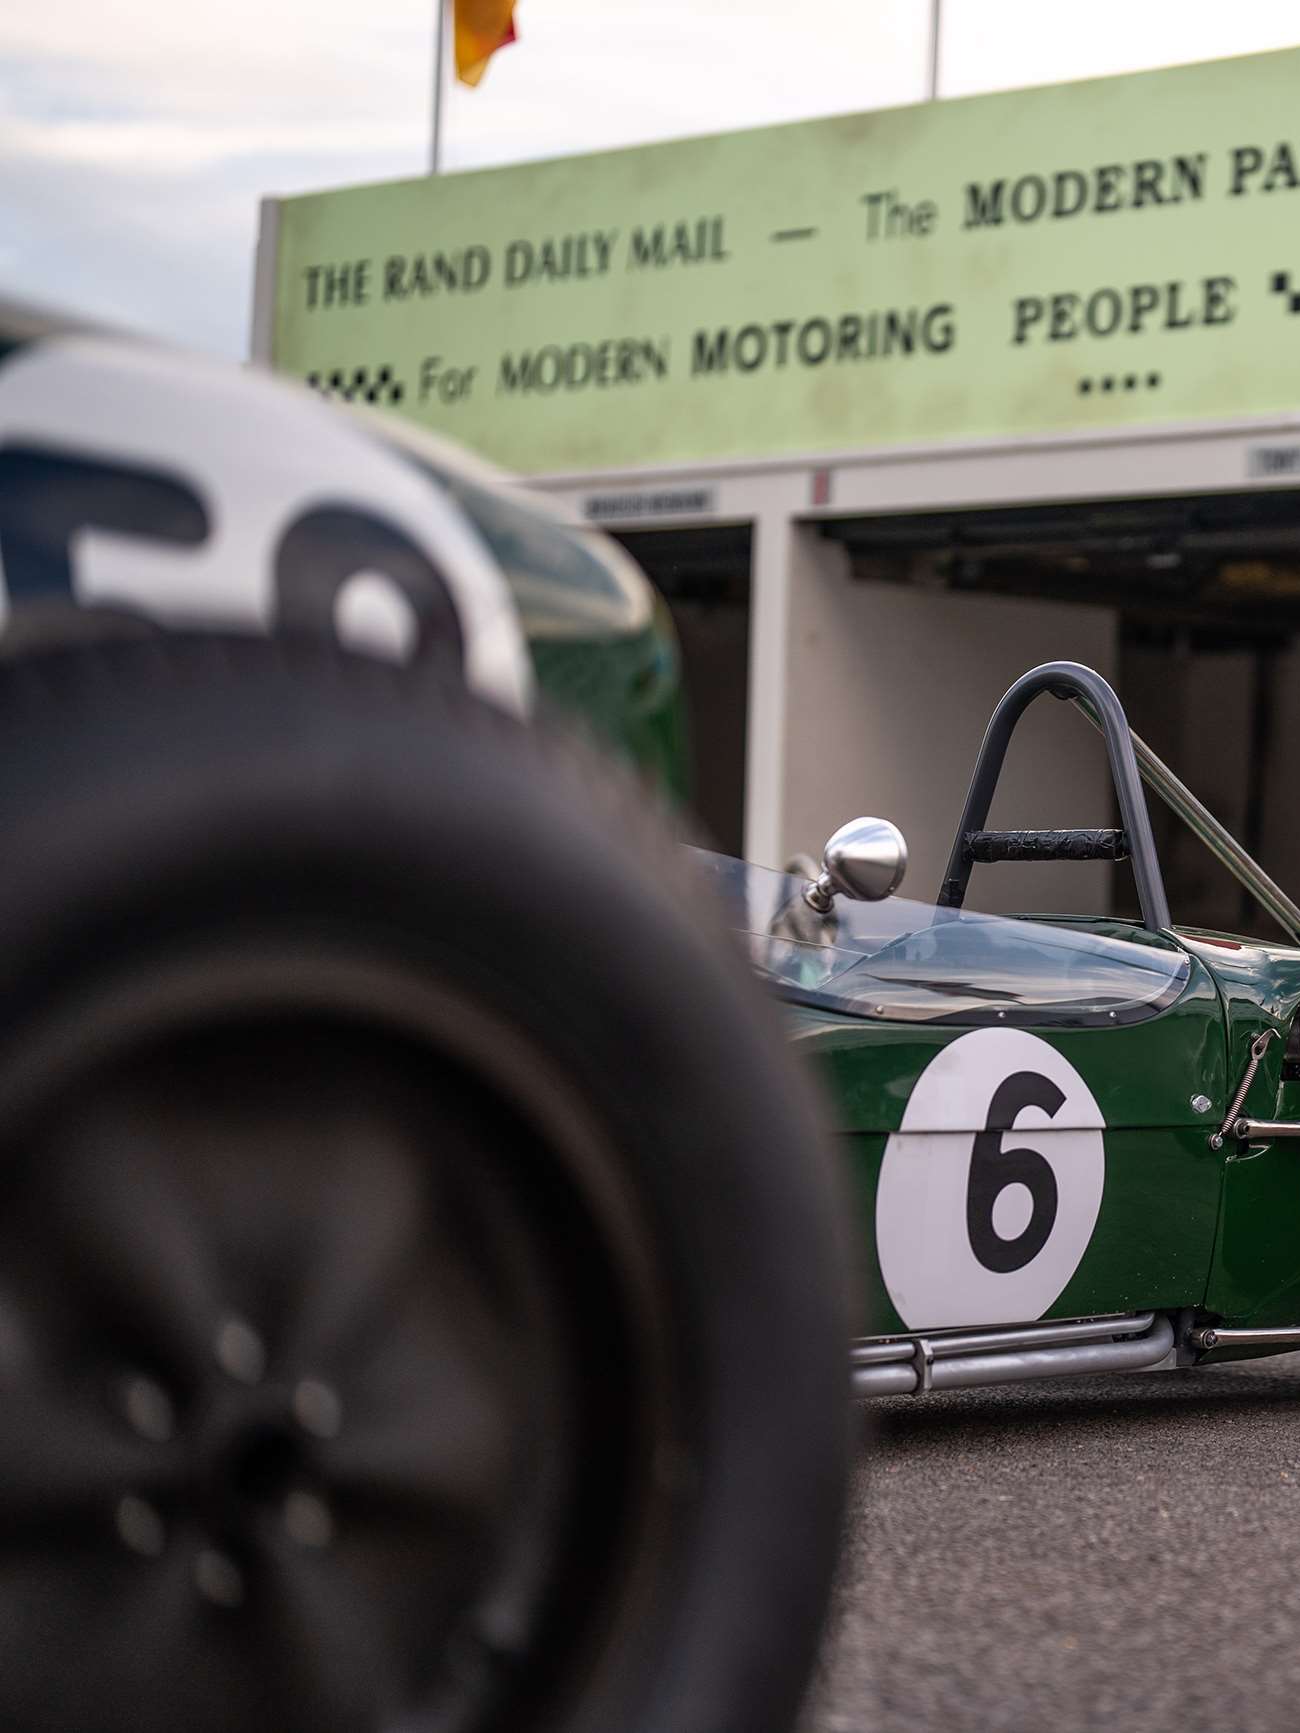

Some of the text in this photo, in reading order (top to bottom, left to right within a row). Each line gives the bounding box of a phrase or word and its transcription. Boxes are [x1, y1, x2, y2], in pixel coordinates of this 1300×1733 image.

[303, 259, 372, 311] THE
[383, 243, 491, 301] RAND
[504, 229, 617, 289] DAILY
[630, 215, 730, 270] MAIL
[863, 190, 937, 242] The
[963, 152, 1208, 232] MODERN
[417, 277, 1237, 406] For MODERN MOTORING PEOPLE
[967, 1070, 1067, 1274] 6
